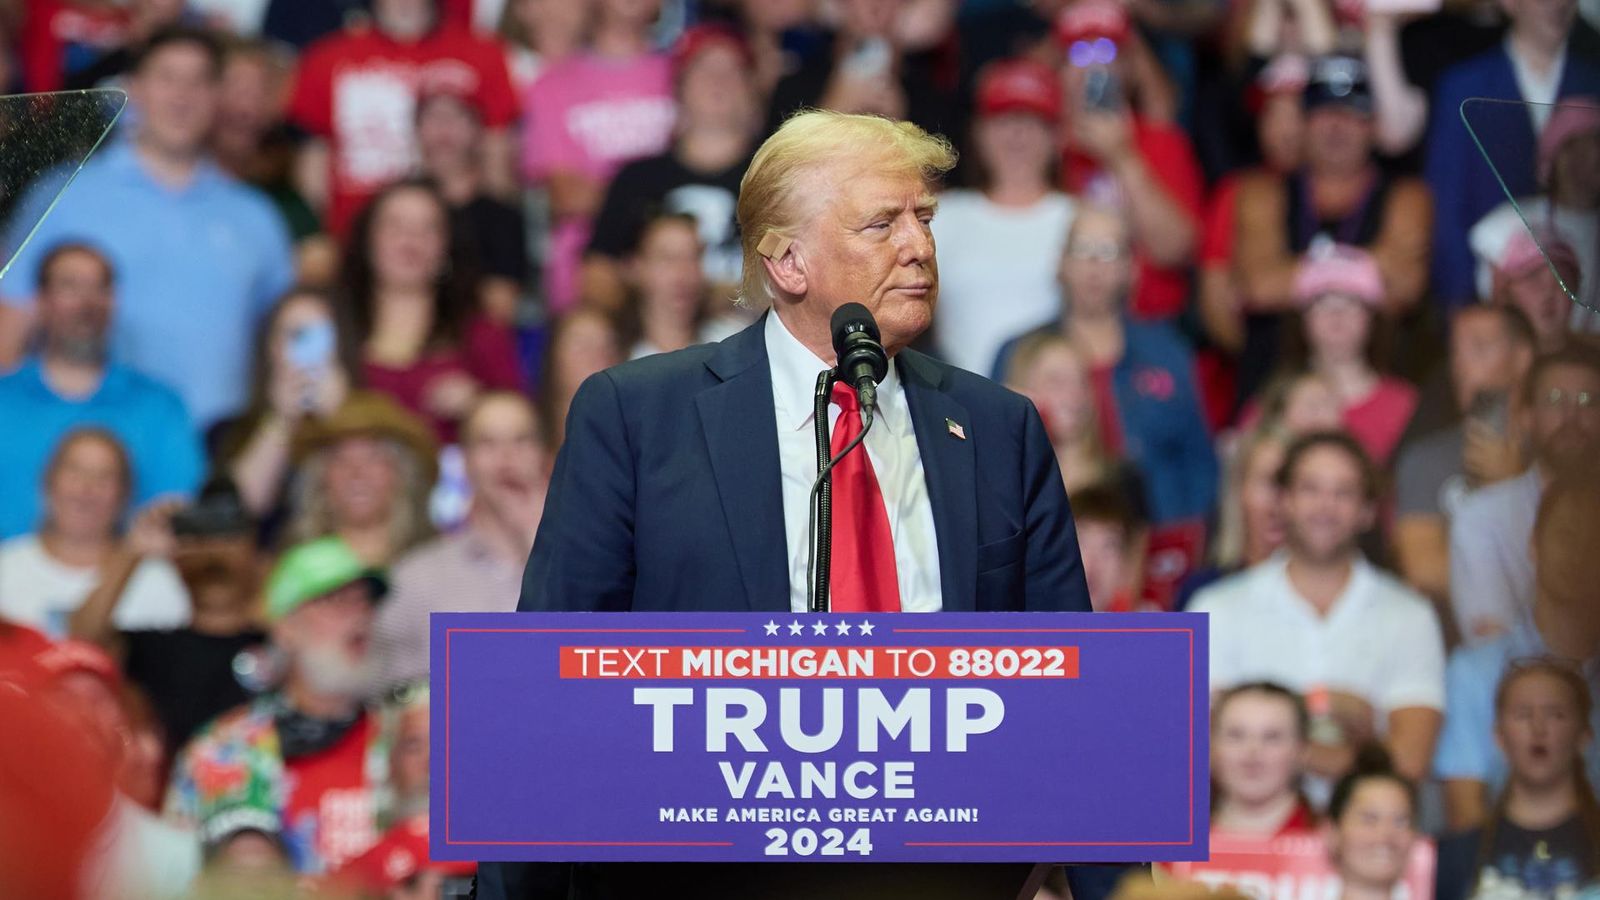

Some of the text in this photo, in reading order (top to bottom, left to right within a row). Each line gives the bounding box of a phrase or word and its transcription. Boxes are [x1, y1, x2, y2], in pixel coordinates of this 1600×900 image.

[573, 647, 1065, 678] TEXT MICHIGAN TO 88022
[633, 687, 1006, 754] TRUMP
[718, 760, 916, 800] VANCE
[659, 807, 979, 823] MAKE AMERICA GREAT AGAIN!
[764, 827, 874, 856] 2024
